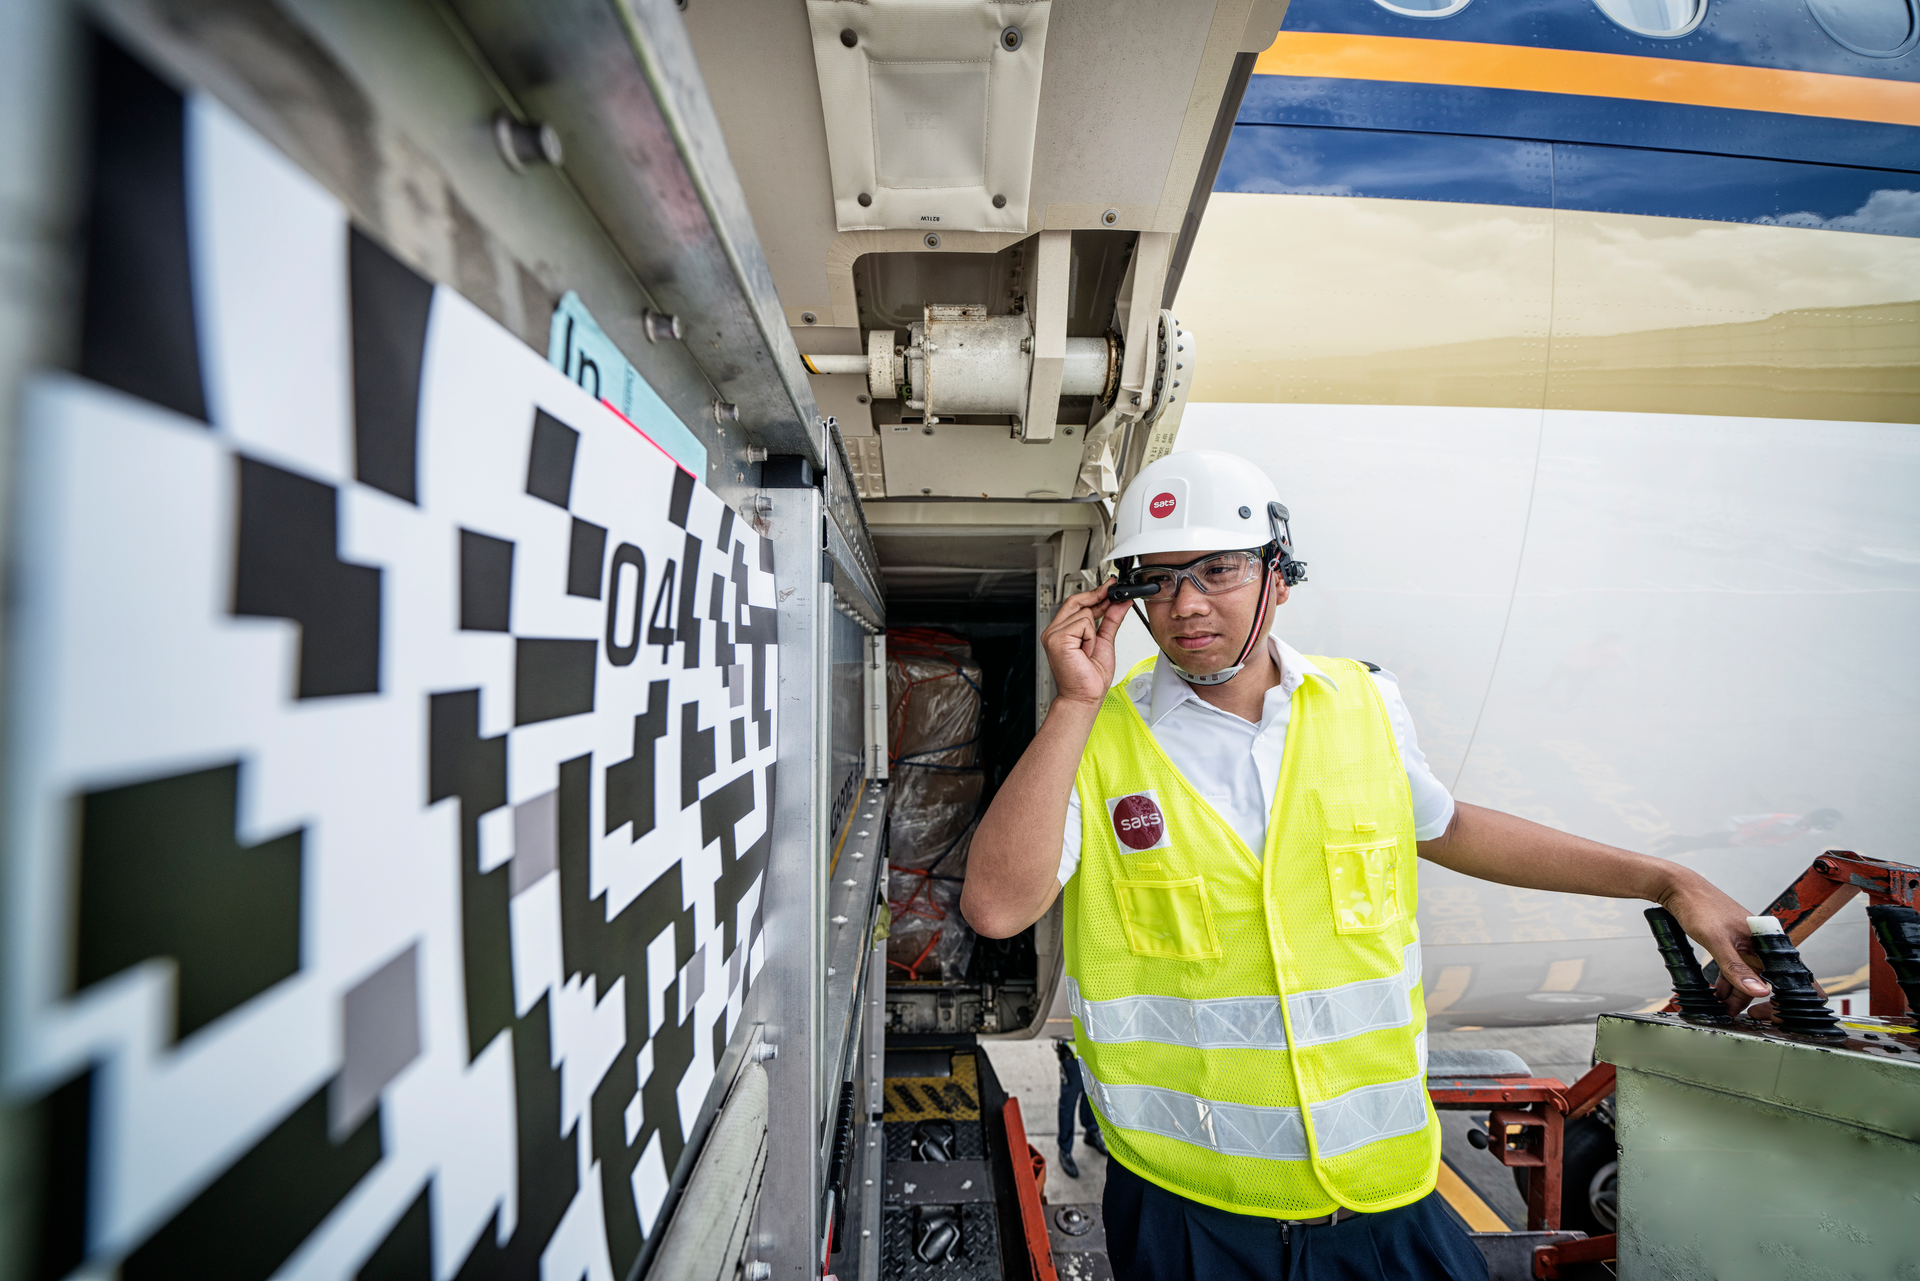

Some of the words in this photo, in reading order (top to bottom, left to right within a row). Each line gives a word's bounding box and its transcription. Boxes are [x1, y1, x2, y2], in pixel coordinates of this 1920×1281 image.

[1153, 499, 1175, 509] sats
[606, 541, 676, 667] 04
[1121, 813, 1161, 831] sats
